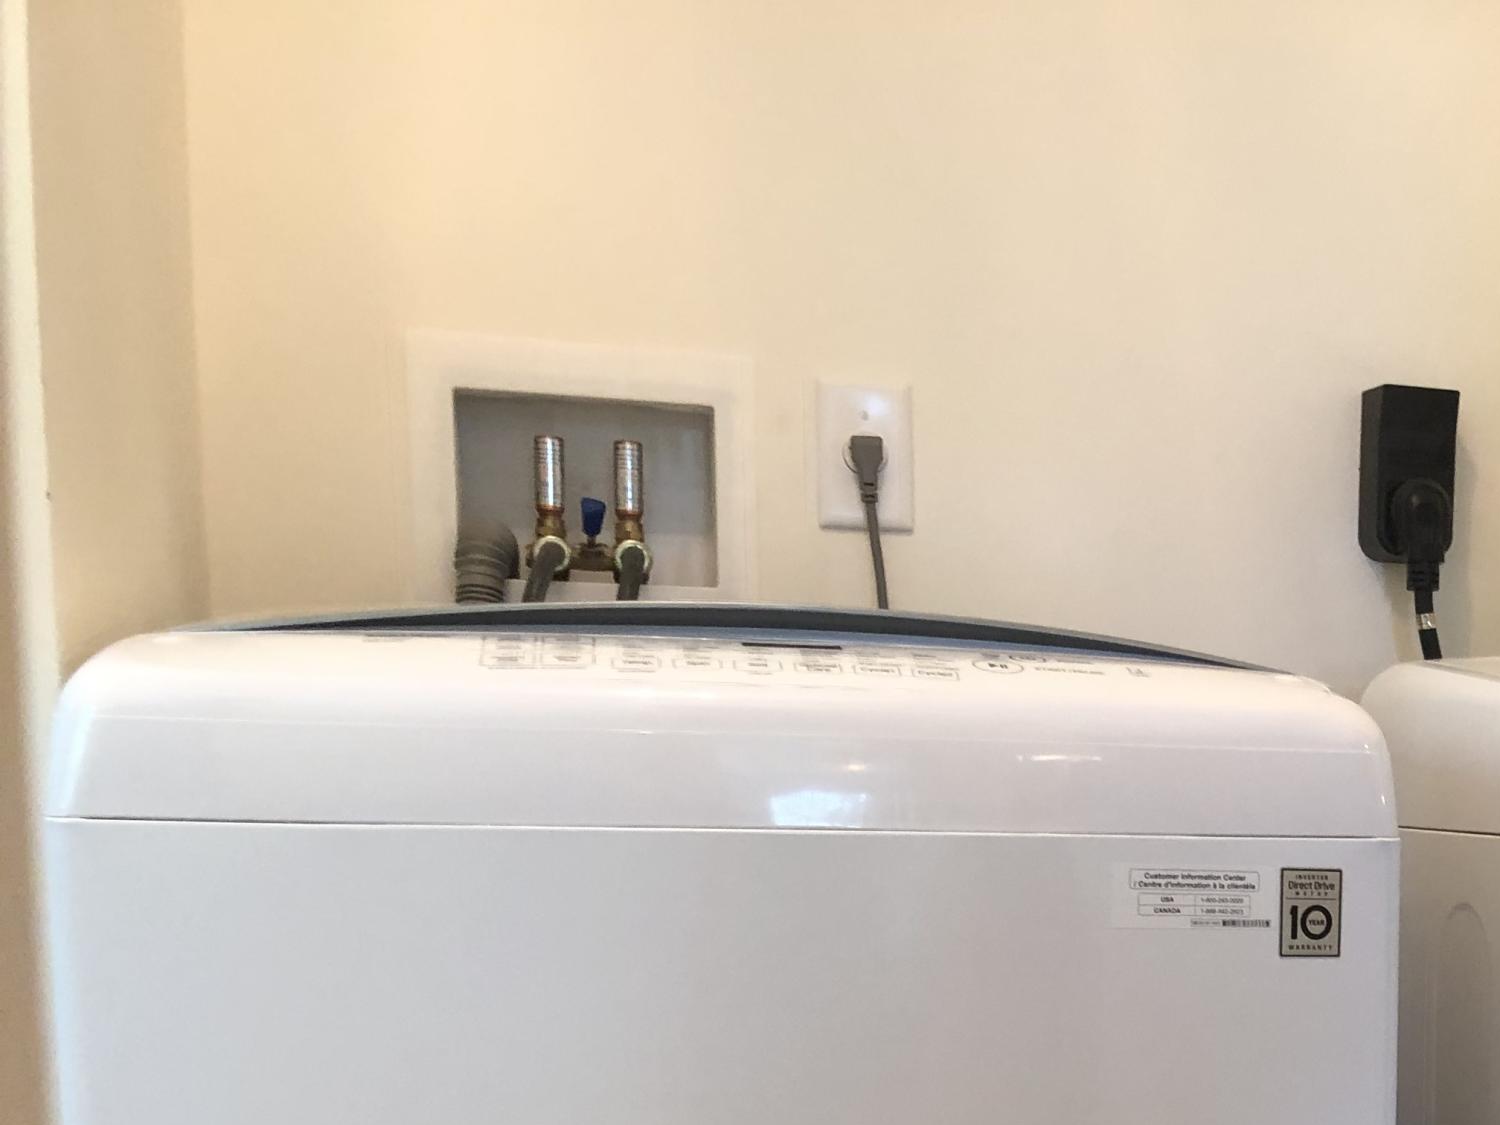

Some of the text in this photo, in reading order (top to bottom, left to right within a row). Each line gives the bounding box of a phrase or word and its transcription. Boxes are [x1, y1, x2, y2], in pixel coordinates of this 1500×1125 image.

[1144, 872, 1246, 882] Customer Information Center
[1288, 881, 1335, 891] Direct Drive
[1153, 906, 1181, 914] CANADA
[1290, 905, 1333, 940] 10
